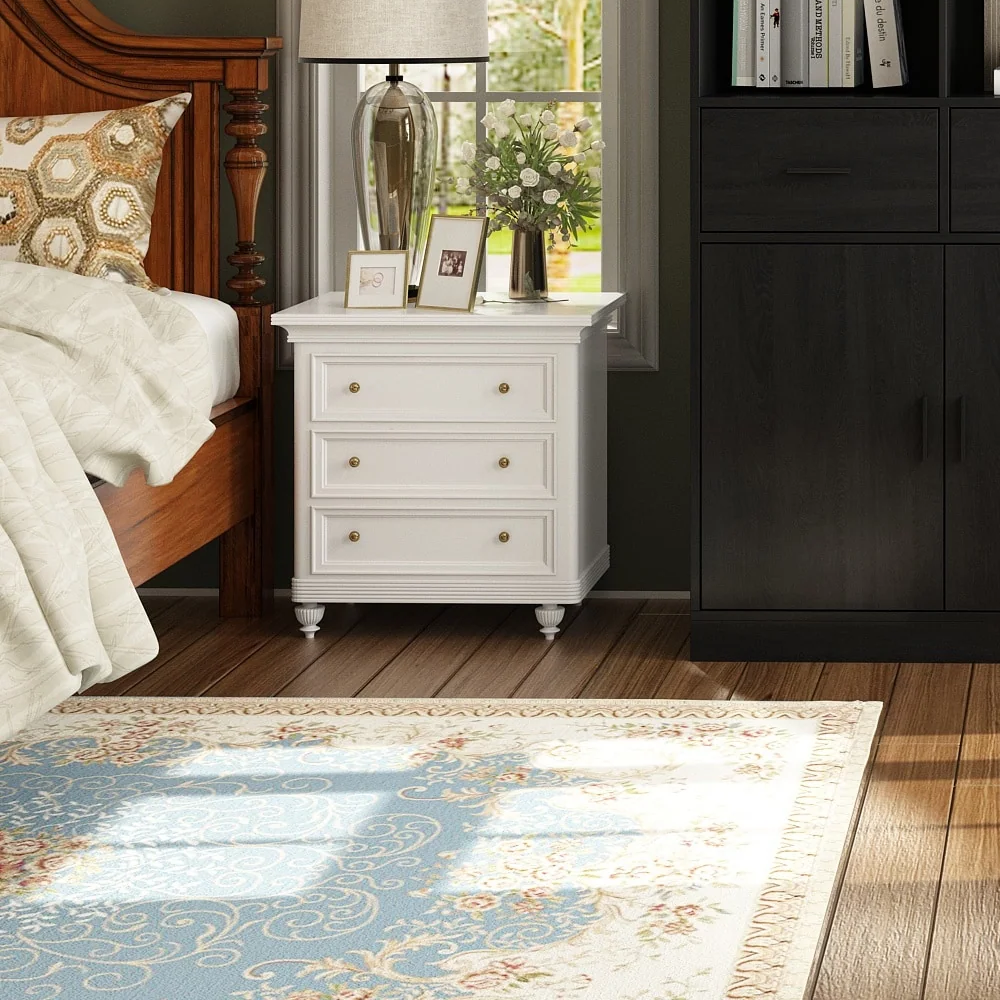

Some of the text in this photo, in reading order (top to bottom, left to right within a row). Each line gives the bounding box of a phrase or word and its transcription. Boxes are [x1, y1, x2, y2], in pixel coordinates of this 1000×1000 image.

[759, 3, 766, 11] An
[815, 0, 823, 18] AND
[875, 4, 884, 16] du
[876, 17, 886, 42] destin
[815, 19, 823, 59] METHODS
